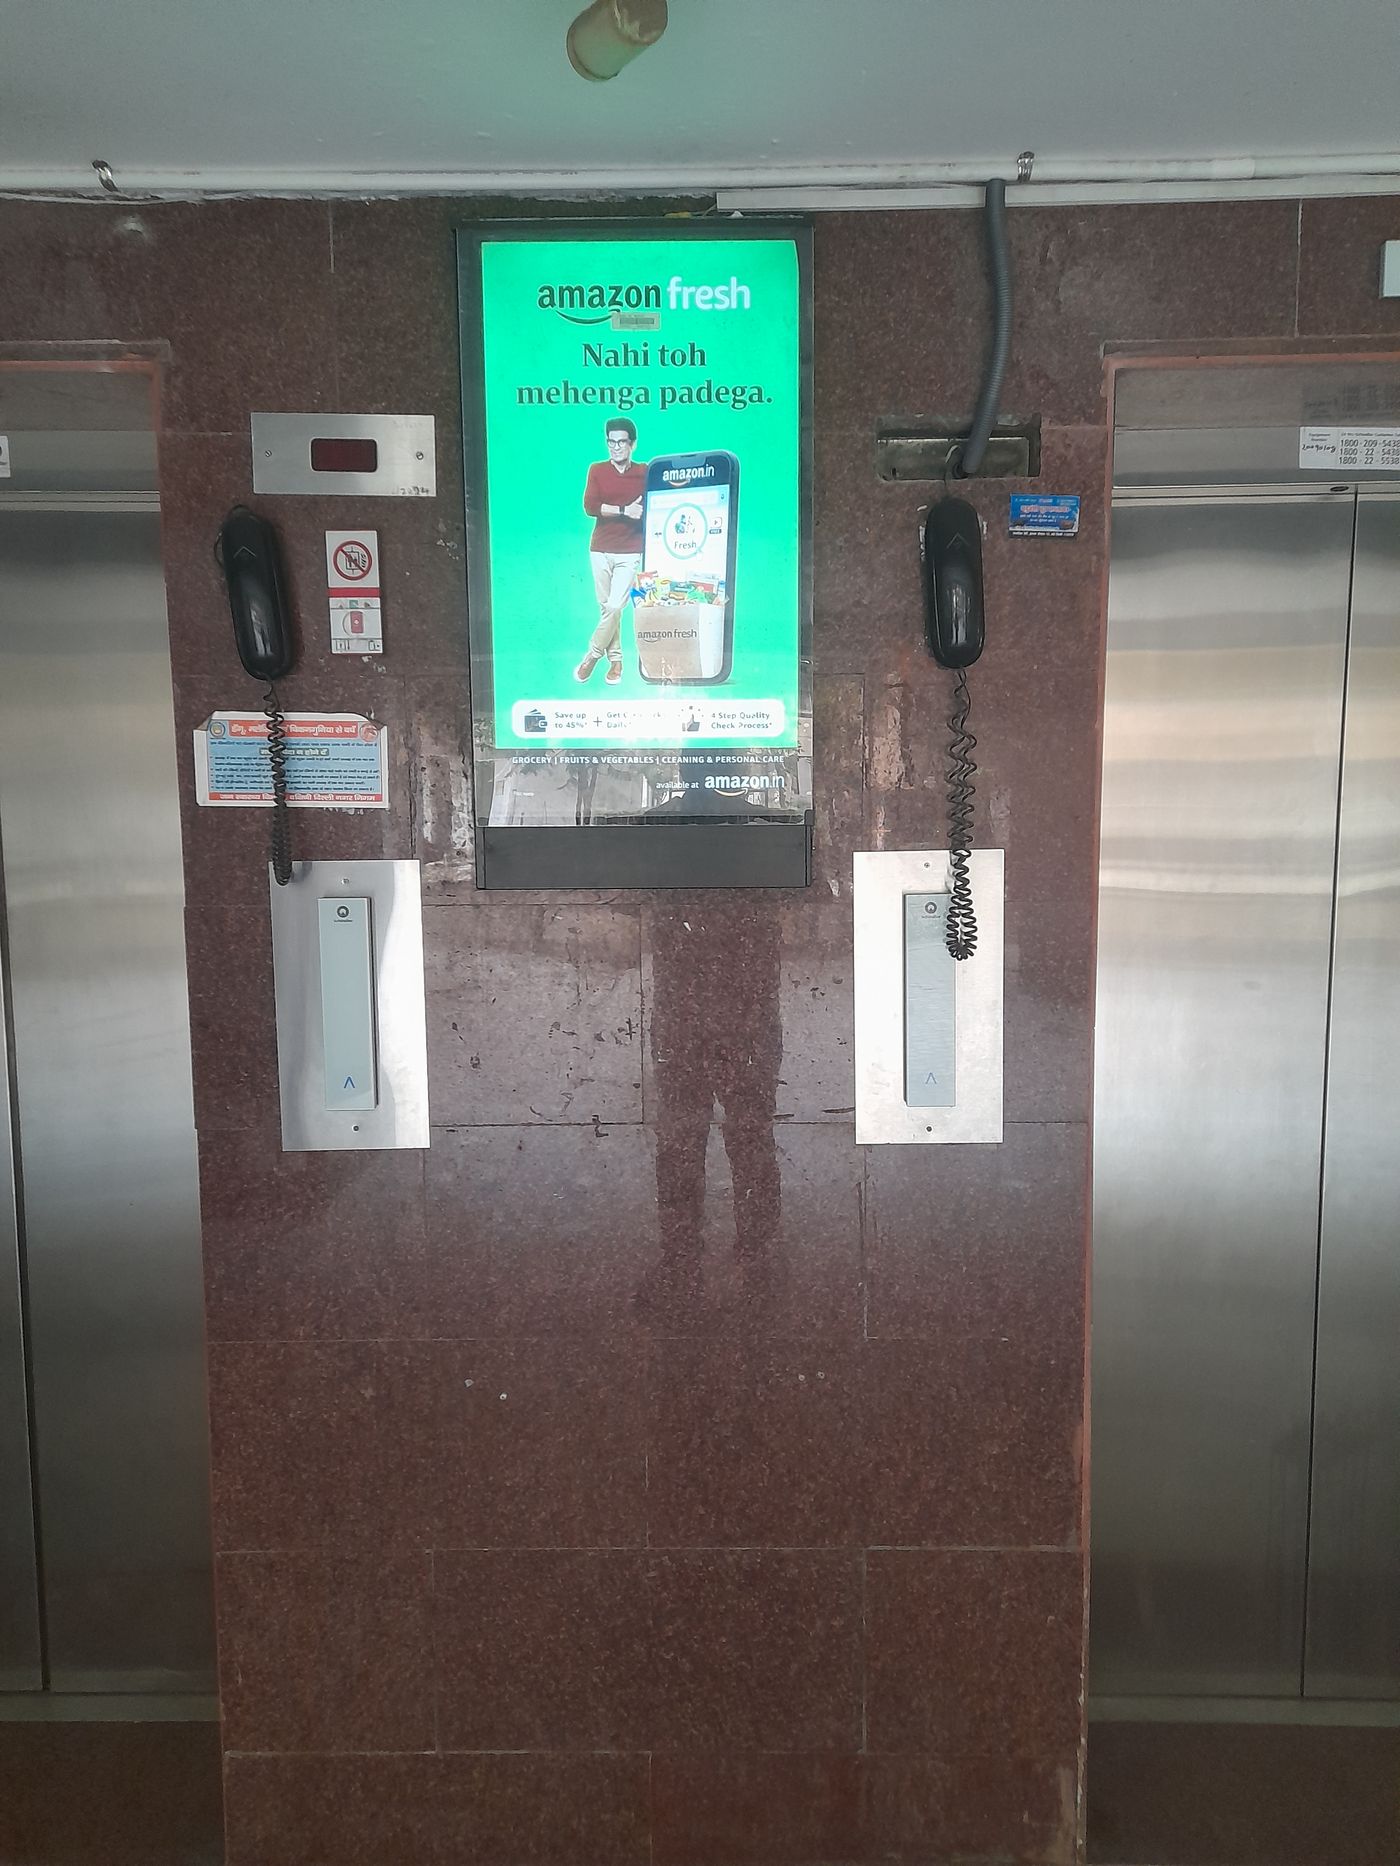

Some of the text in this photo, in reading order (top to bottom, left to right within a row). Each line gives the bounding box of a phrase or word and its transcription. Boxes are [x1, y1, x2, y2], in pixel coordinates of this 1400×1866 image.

[537, 276, 751, 310] amazon fresh
[583, 342, 707, 367] Nahi toh
[517, 380, 773, 410] mehenga padega.
[1341, 439, 1359, 447] 1800
[1340, 448, 1358, 456] 1800
[1339, 456, 1358, 464] 1800
[662, 464, 715, 482] amazon.in
[674, 540, 697, 550] Fresh
[638, 628, 697, 640] amazon fresh
[554, 711, 574, 719] Save
[606, 711, 621, 719] Get
[718, 712, 737, 720] Step
[739, 711, 770, 720] Quality
[710, 721, 736, 729] Check
[512, 755, 784, 764] GROCERY FRUITS & VEGETABLES CLEANING & PERSONAL CARE
[656, 781, 689, 789] available
[705, 775, 785, 789] amazon.in
